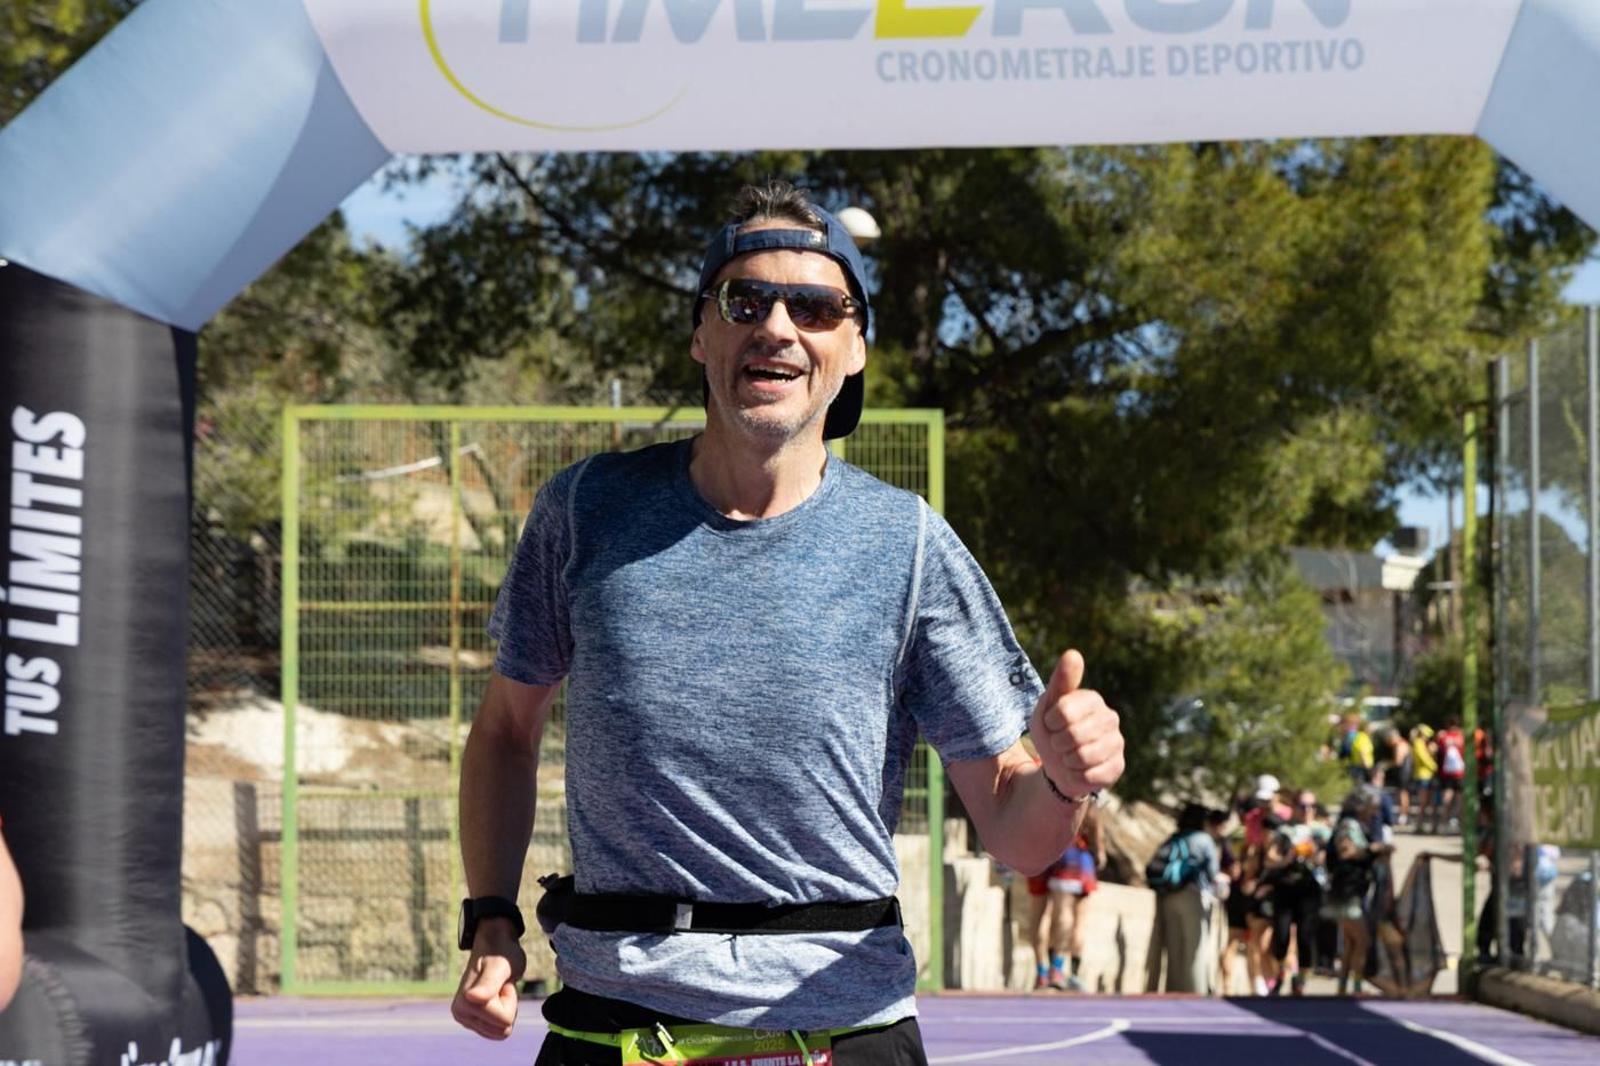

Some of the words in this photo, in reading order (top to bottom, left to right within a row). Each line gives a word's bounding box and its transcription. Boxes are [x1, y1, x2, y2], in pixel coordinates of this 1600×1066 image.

[875, 44, 1156, 83] CRONOMETRAJE
[1167, 38, 1365, 77] DEPORTIVO
[5, 653, 61, 735] TUS
[754, 1039, 786, 1051] 2025
[788, 1055, 800, 1065] LA
